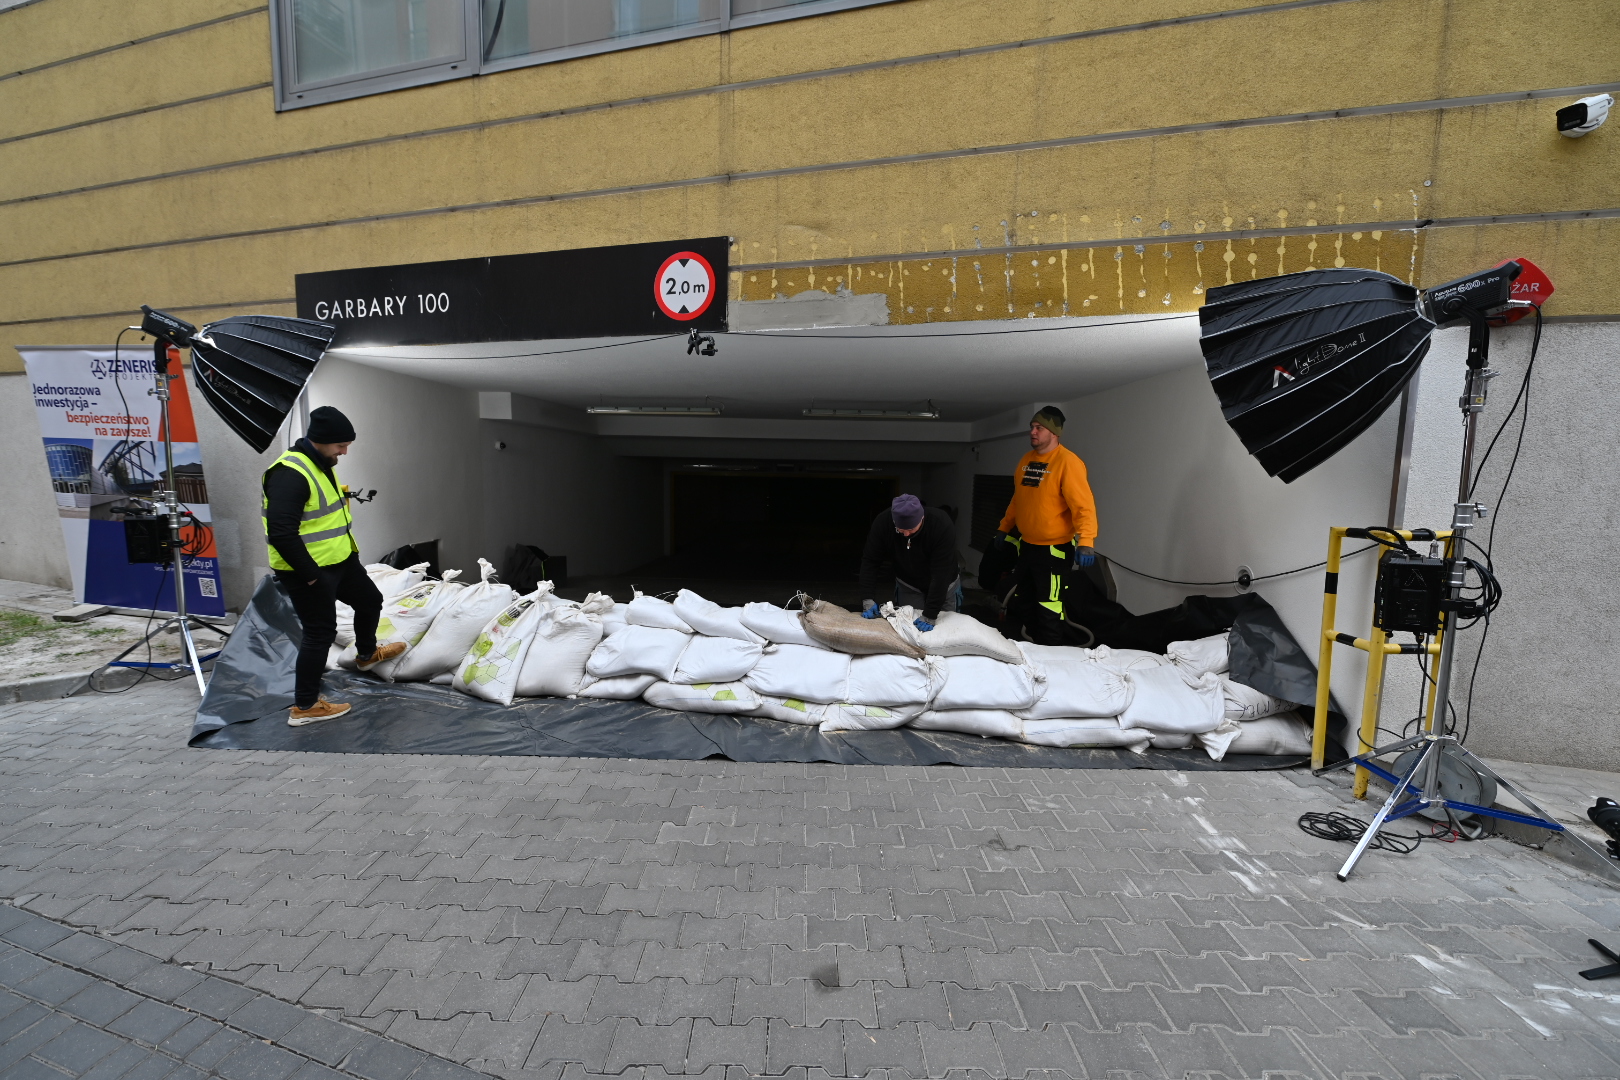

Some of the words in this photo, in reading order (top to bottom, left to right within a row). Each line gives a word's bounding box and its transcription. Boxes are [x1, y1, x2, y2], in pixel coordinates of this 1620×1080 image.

[665, 277, 690, 295] 2,0
[693, 283, 705, 293] m
[1487, 276, 1500, 284] Pro
[1510, 281, 1540, 294] ŻAR
[315, 295, 407, 320] GARBARY
[417, 292, 450, 314] 100
[106, 359, 159, 373] ZENERIS
[109, 373, 155, 381] PROJEKT
[32, 383, 101, 396] Jednorazowa
[34, 396, 89, 411] inwestycja
[65, 411, 149, 426] bezpieczeństwo
[95, 427, 107, 436] na
[110, 426, 152, 437] zawsze!
